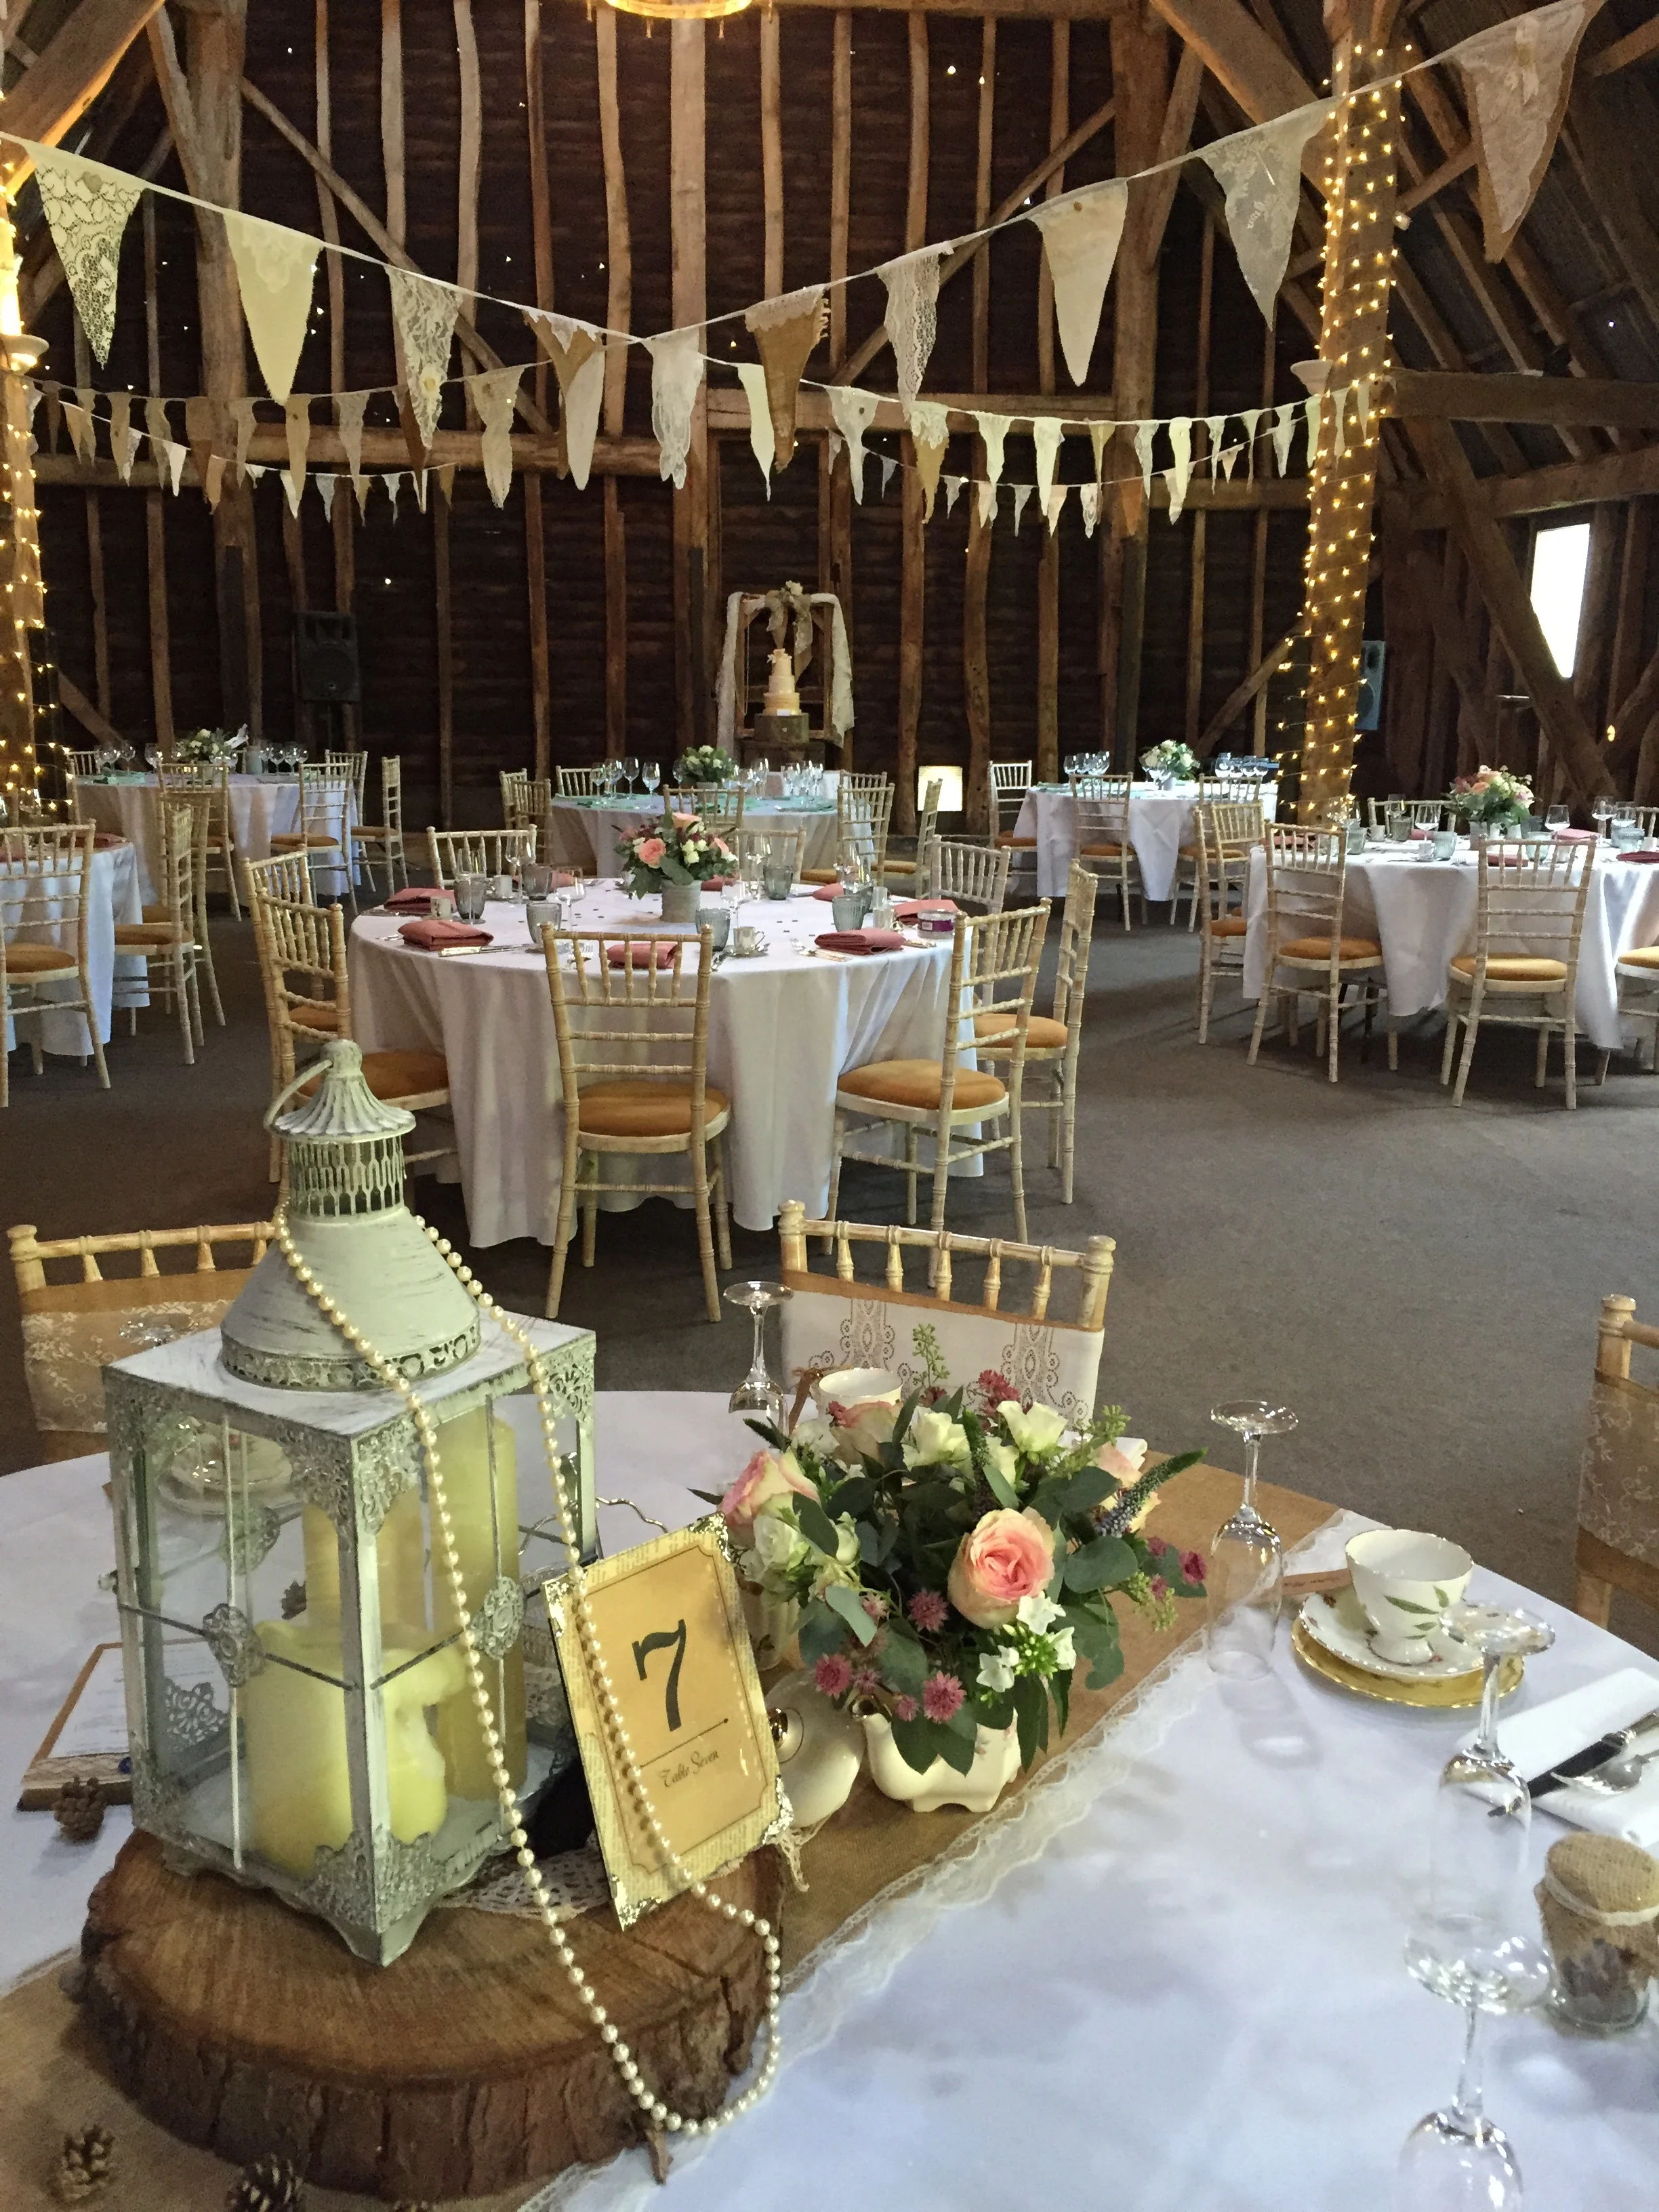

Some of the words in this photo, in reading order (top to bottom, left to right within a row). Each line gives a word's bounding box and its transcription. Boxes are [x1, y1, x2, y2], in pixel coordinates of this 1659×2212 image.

[631, 1618, 687, 1732] 7
[659, 1763, 690, 1787] Table
[690, 1750, 719, 1774] Seven
